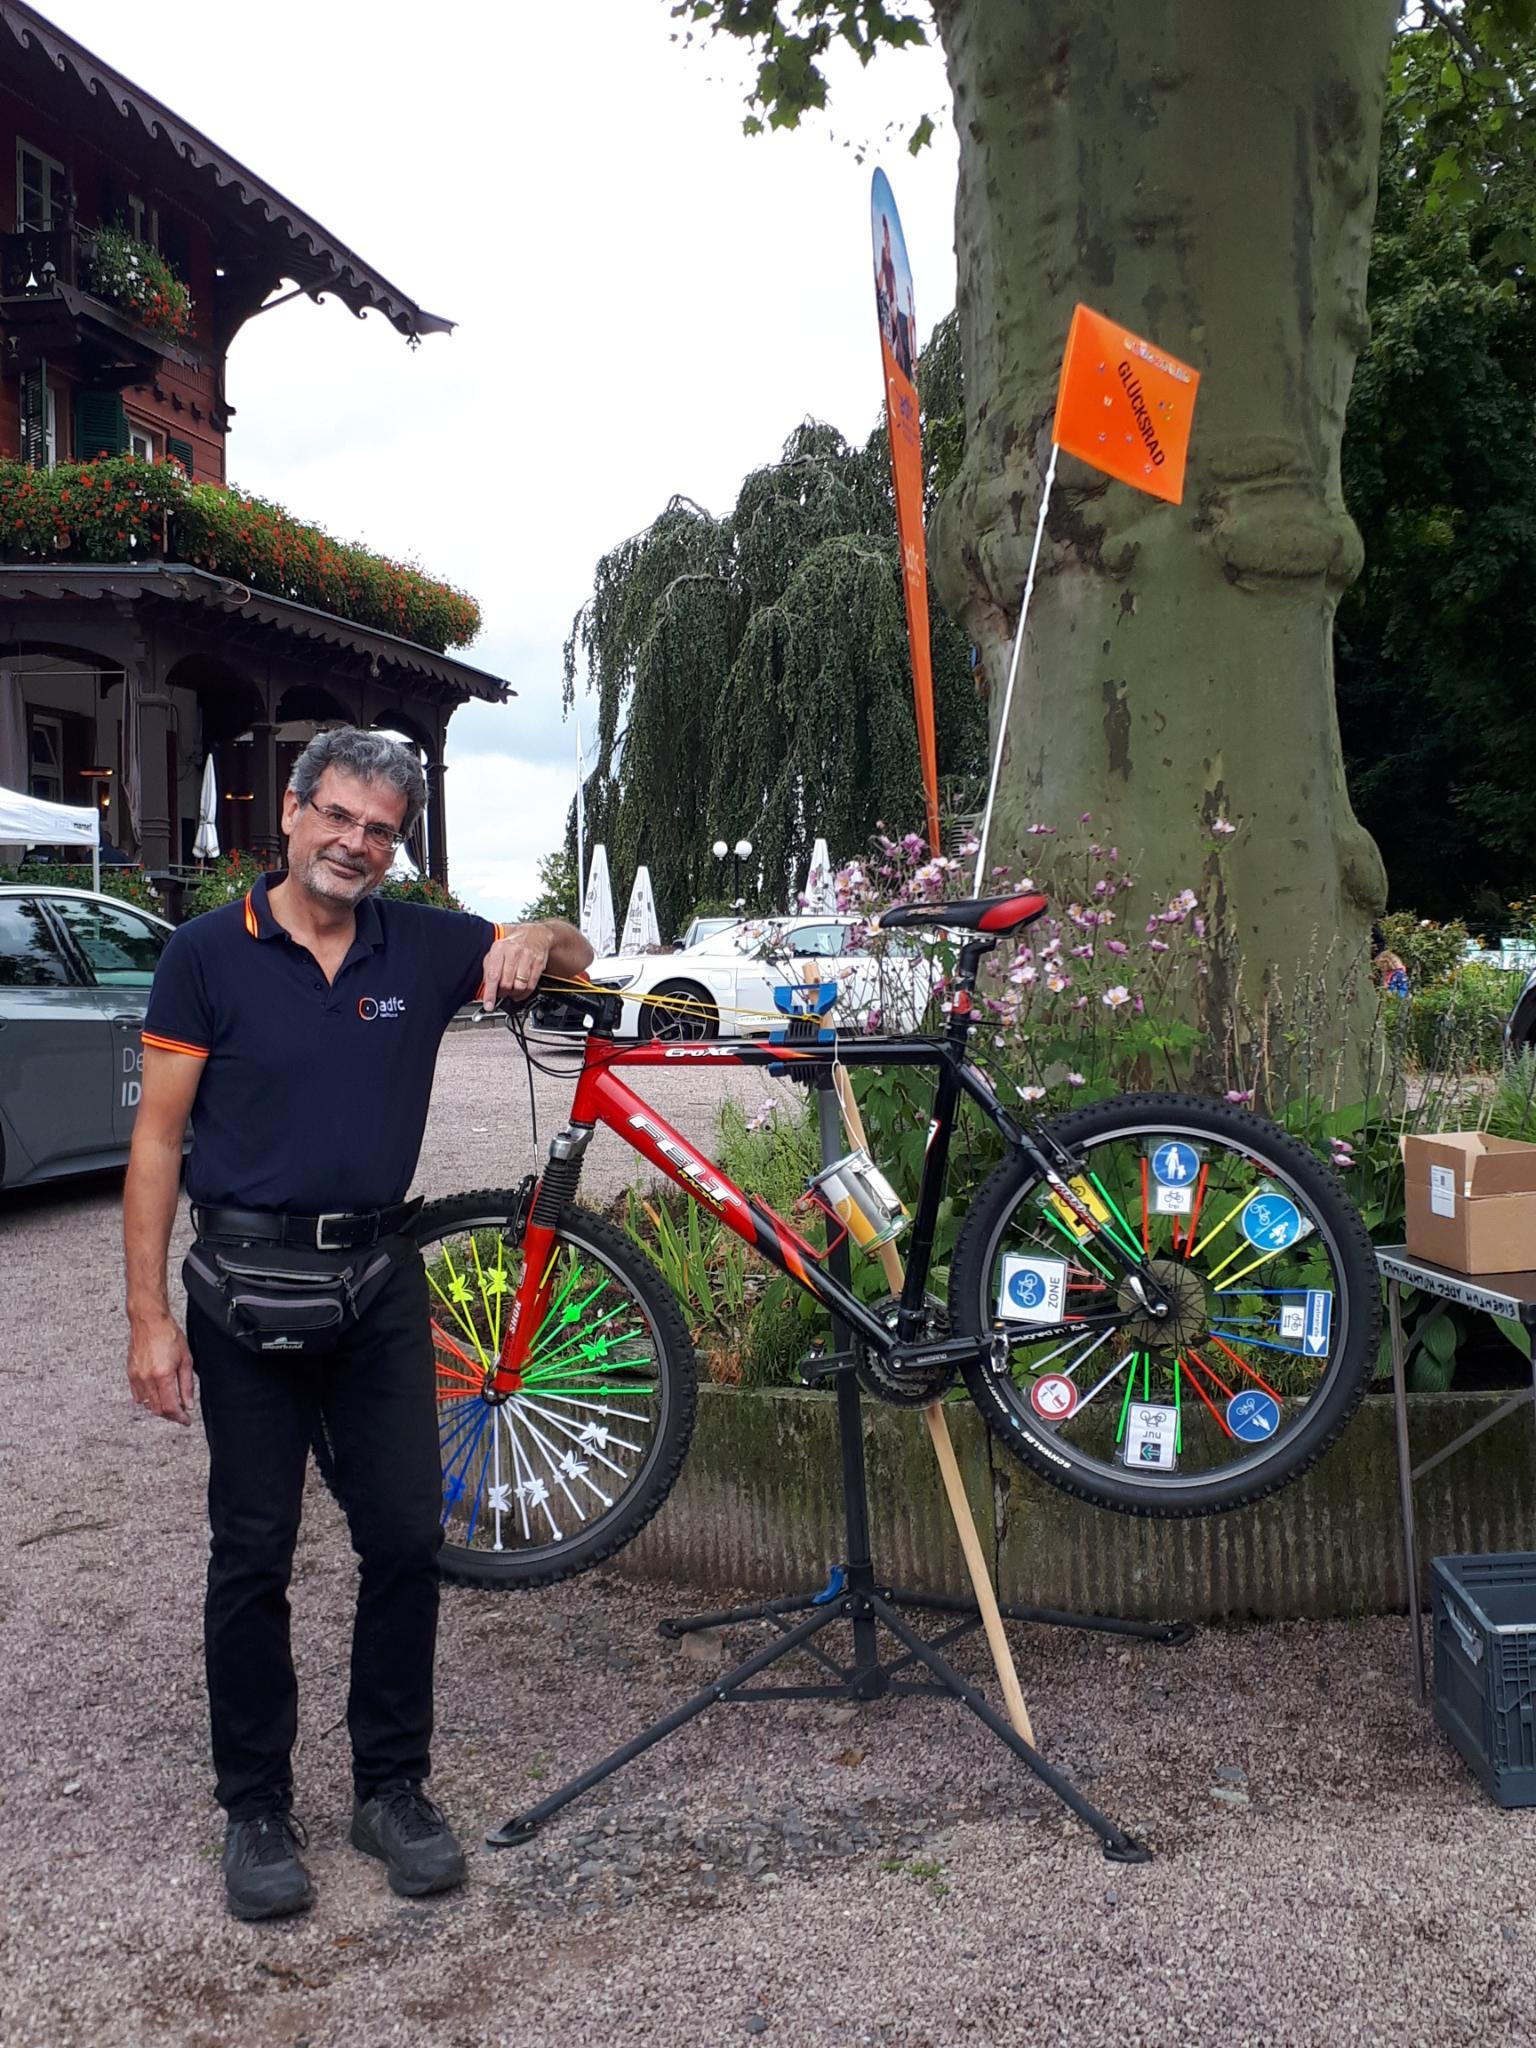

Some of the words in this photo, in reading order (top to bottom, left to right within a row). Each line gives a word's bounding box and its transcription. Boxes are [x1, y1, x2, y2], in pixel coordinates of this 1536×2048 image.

[379, 997, 406, 1011] adfc
[627, 1112, 741, 1206] FELT
[677, 1168, 725, 1211] RACING
[1048, 1276, 1060, 1309] ZONE
[509, 1300, 521, 1334] SHOX
[988, 1384, 1009, 1414] SMART
[1021, 1431, 1072, 1469] SCHWALBE
[1142, 1431, 1162, 1440] nur
